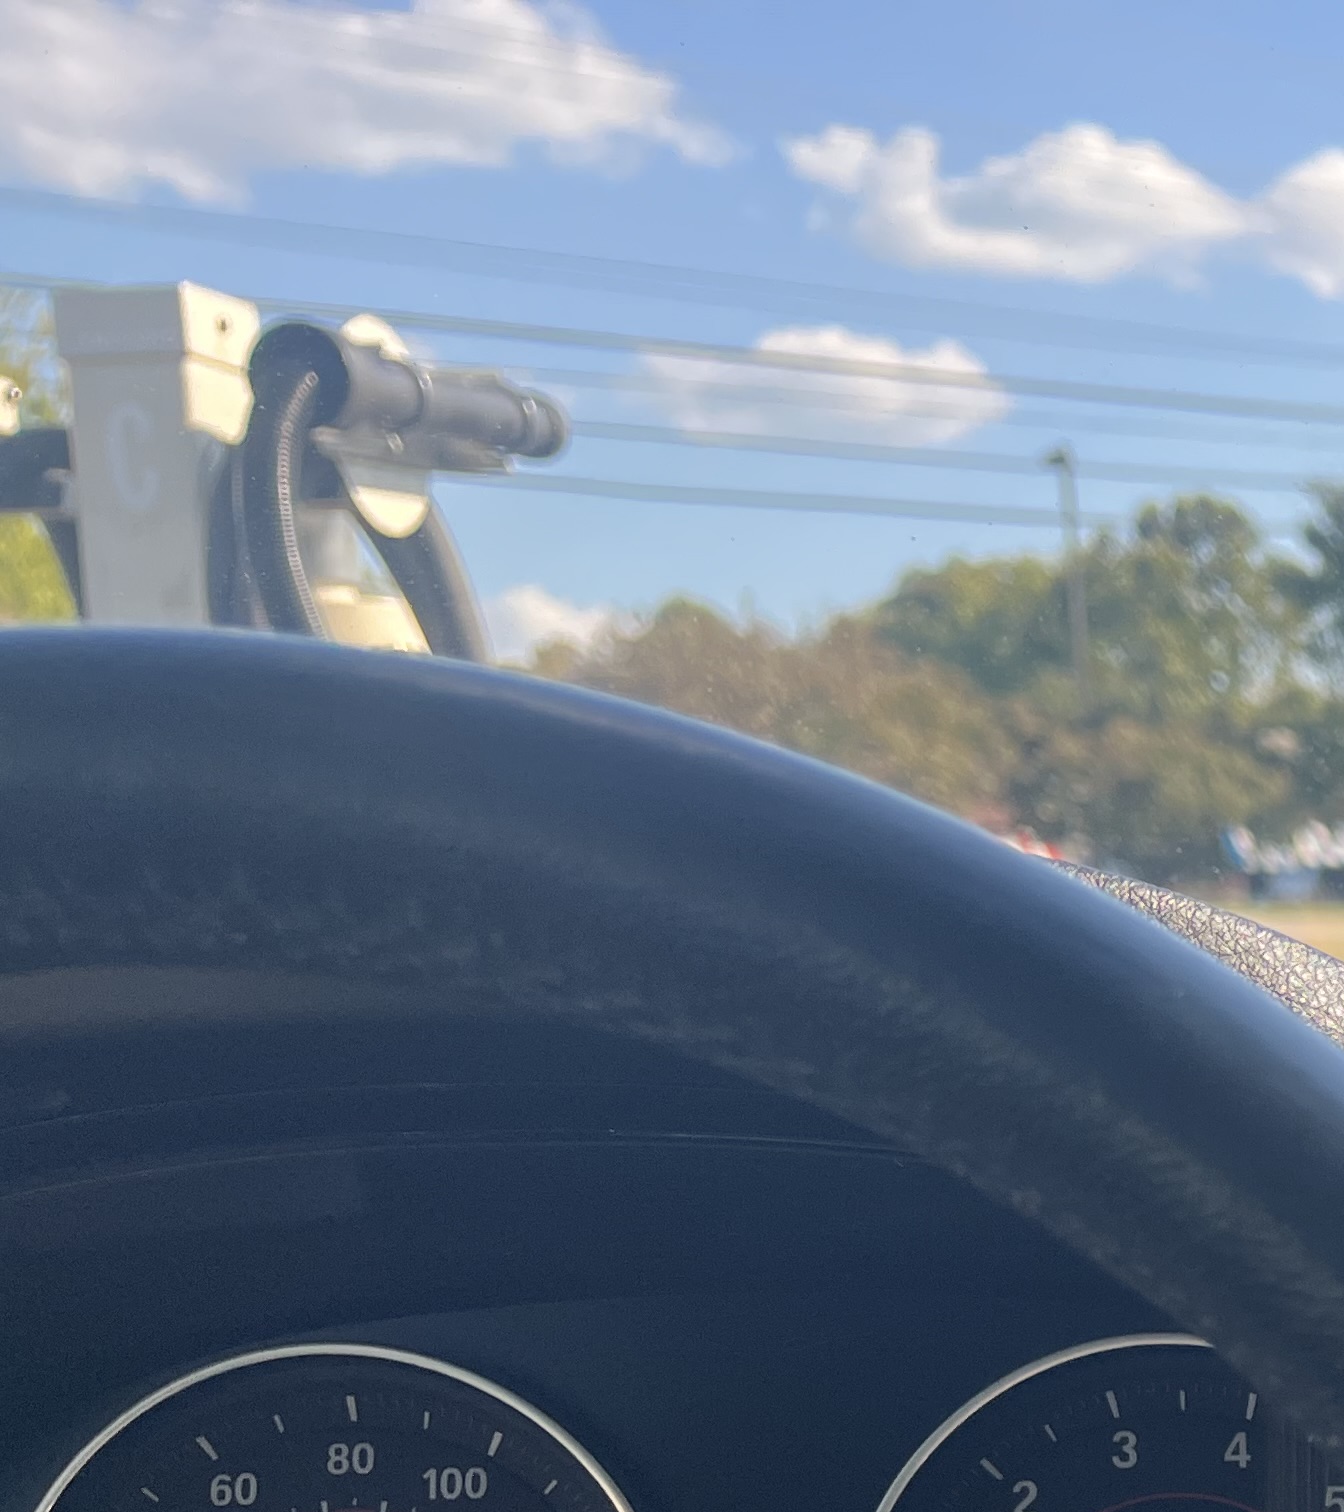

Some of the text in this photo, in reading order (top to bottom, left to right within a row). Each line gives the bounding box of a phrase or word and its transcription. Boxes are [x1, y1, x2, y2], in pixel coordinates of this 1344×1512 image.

[327, 1443, 374, 1474] 80
[1112, 1431, 1137, 1468] 3
[1224, 1432, 1251, 1468] 4
[211, 1473, 257, 1506] 60
[423, 1468, 487, 1499] 100
